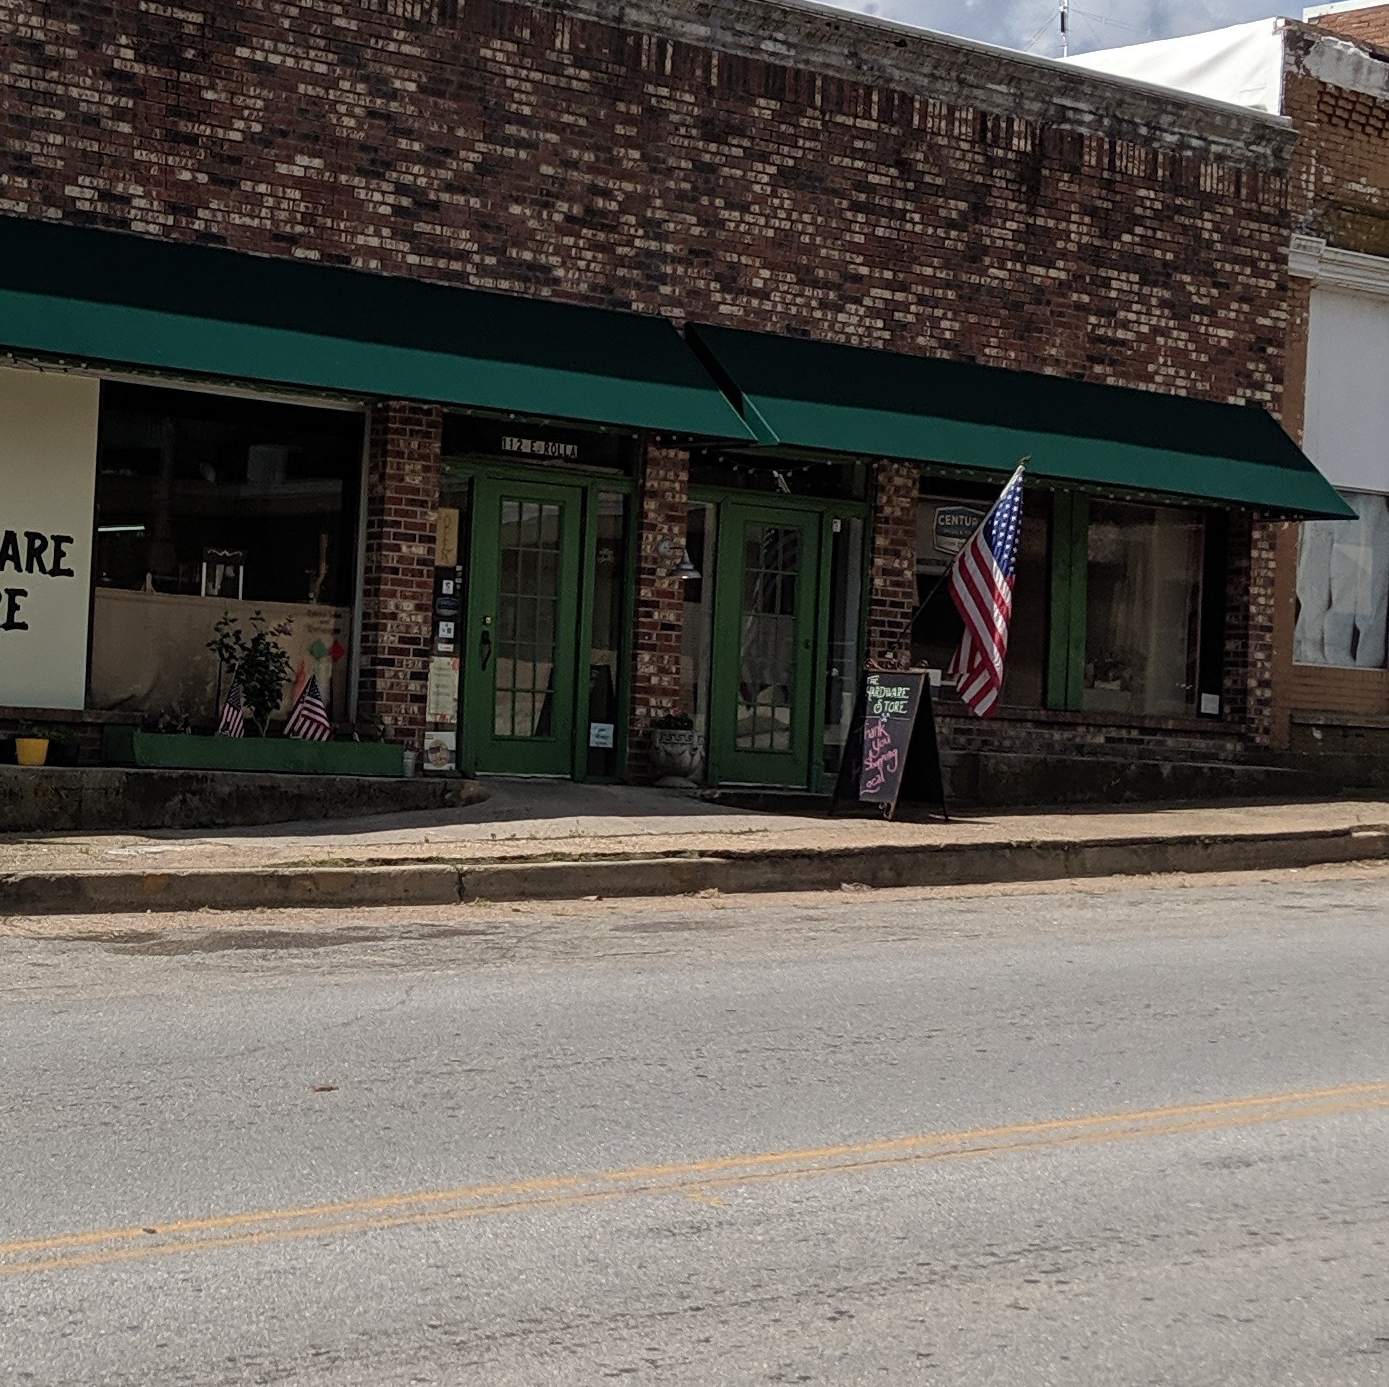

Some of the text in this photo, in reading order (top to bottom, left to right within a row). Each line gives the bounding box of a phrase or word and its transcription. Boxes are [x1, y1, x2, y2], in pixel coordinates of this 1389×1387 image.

[502, 437, 523, 452] 112
[544, 441, 576, 458] ROLLA
[937, 514, 980, 527] CENTUR
